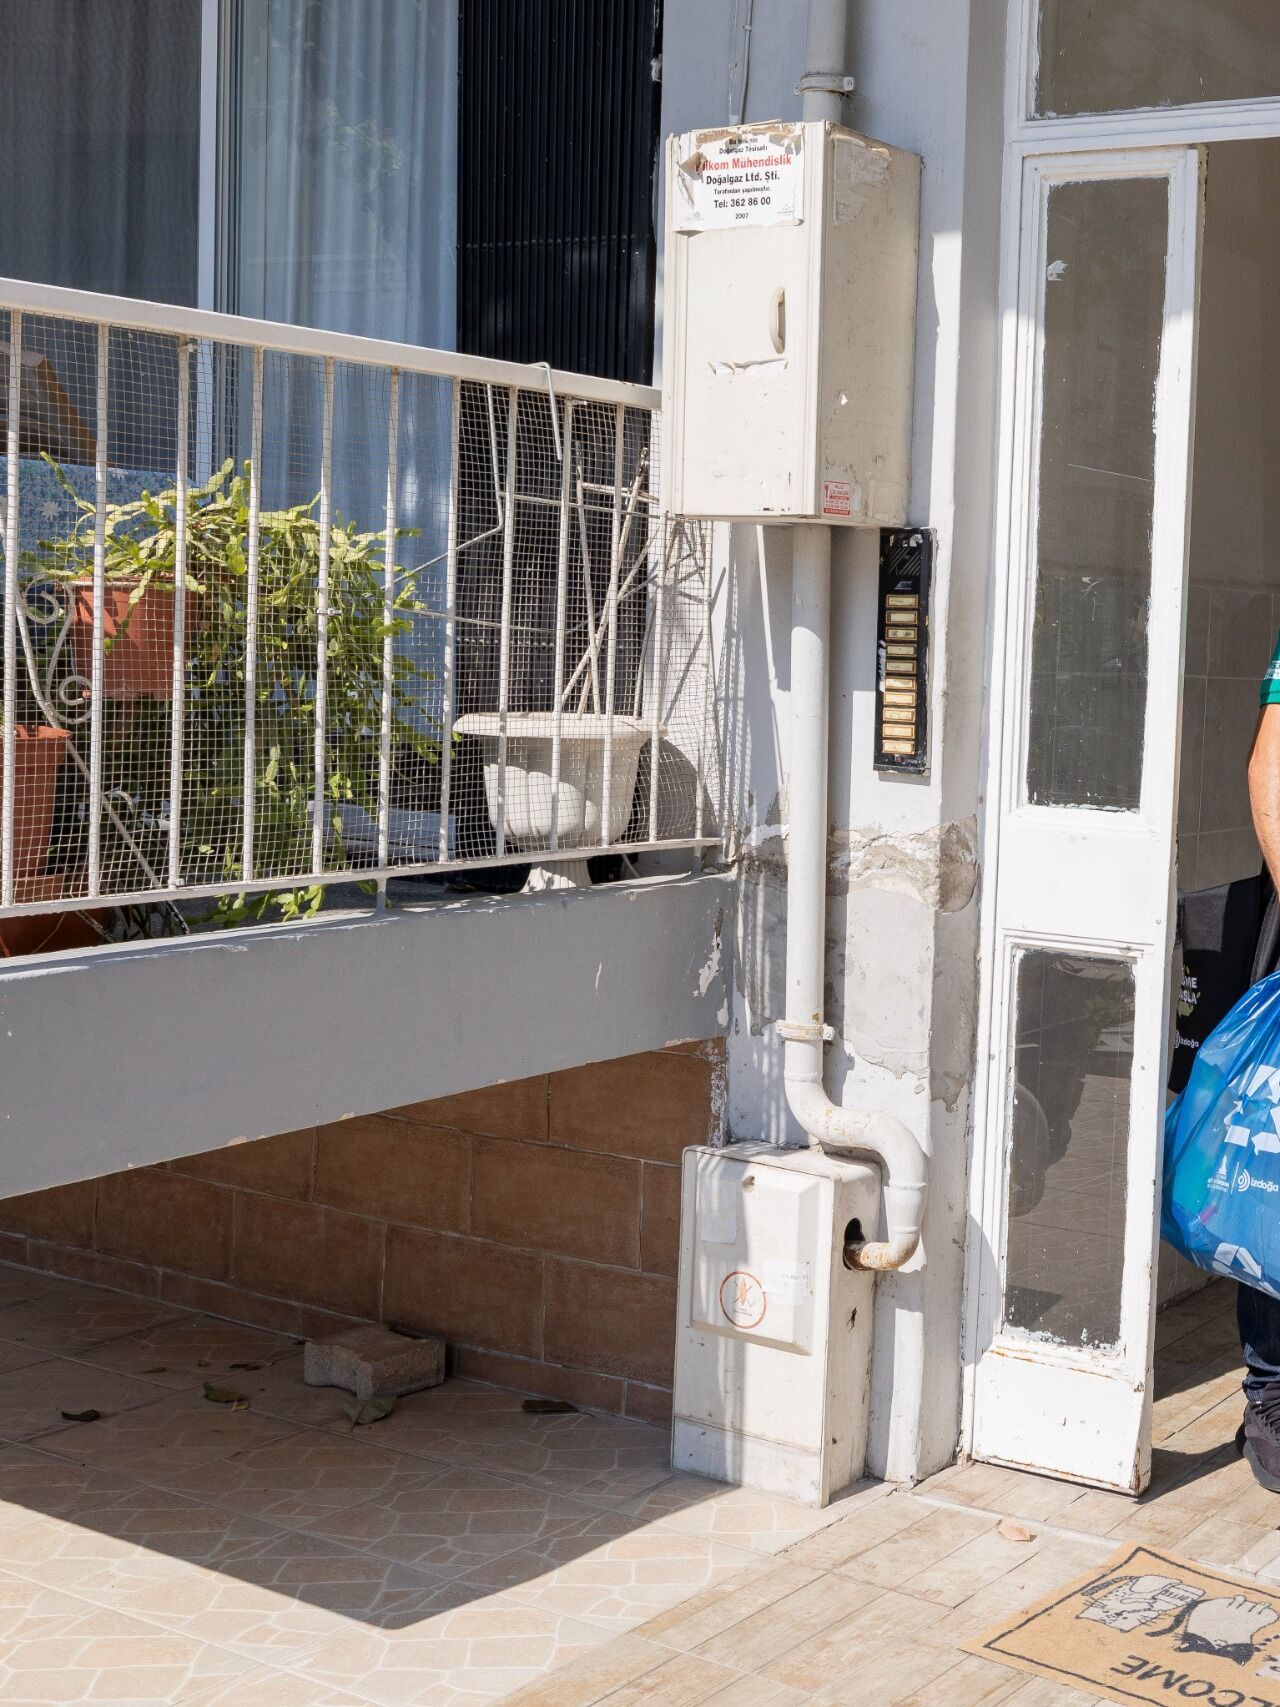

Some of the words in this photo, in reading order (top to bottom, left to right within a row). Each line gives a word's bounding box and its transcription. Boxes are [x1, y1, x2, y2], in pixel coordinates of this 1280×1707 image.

[732, 154, 792, 170] Mühendislik
[706, 174, 743, 186] Doğalgaz
[745, 172, 762, 182] Ltd.
[764, 171, 780, 183] Şti.
[714, 199, 728, 209] Tel:
[730, 198, 746, 208] 362
[747, 196, 759, 207] 86
[760, 196, 771, 206] 00
[735, 212, 749, 220] 2007
